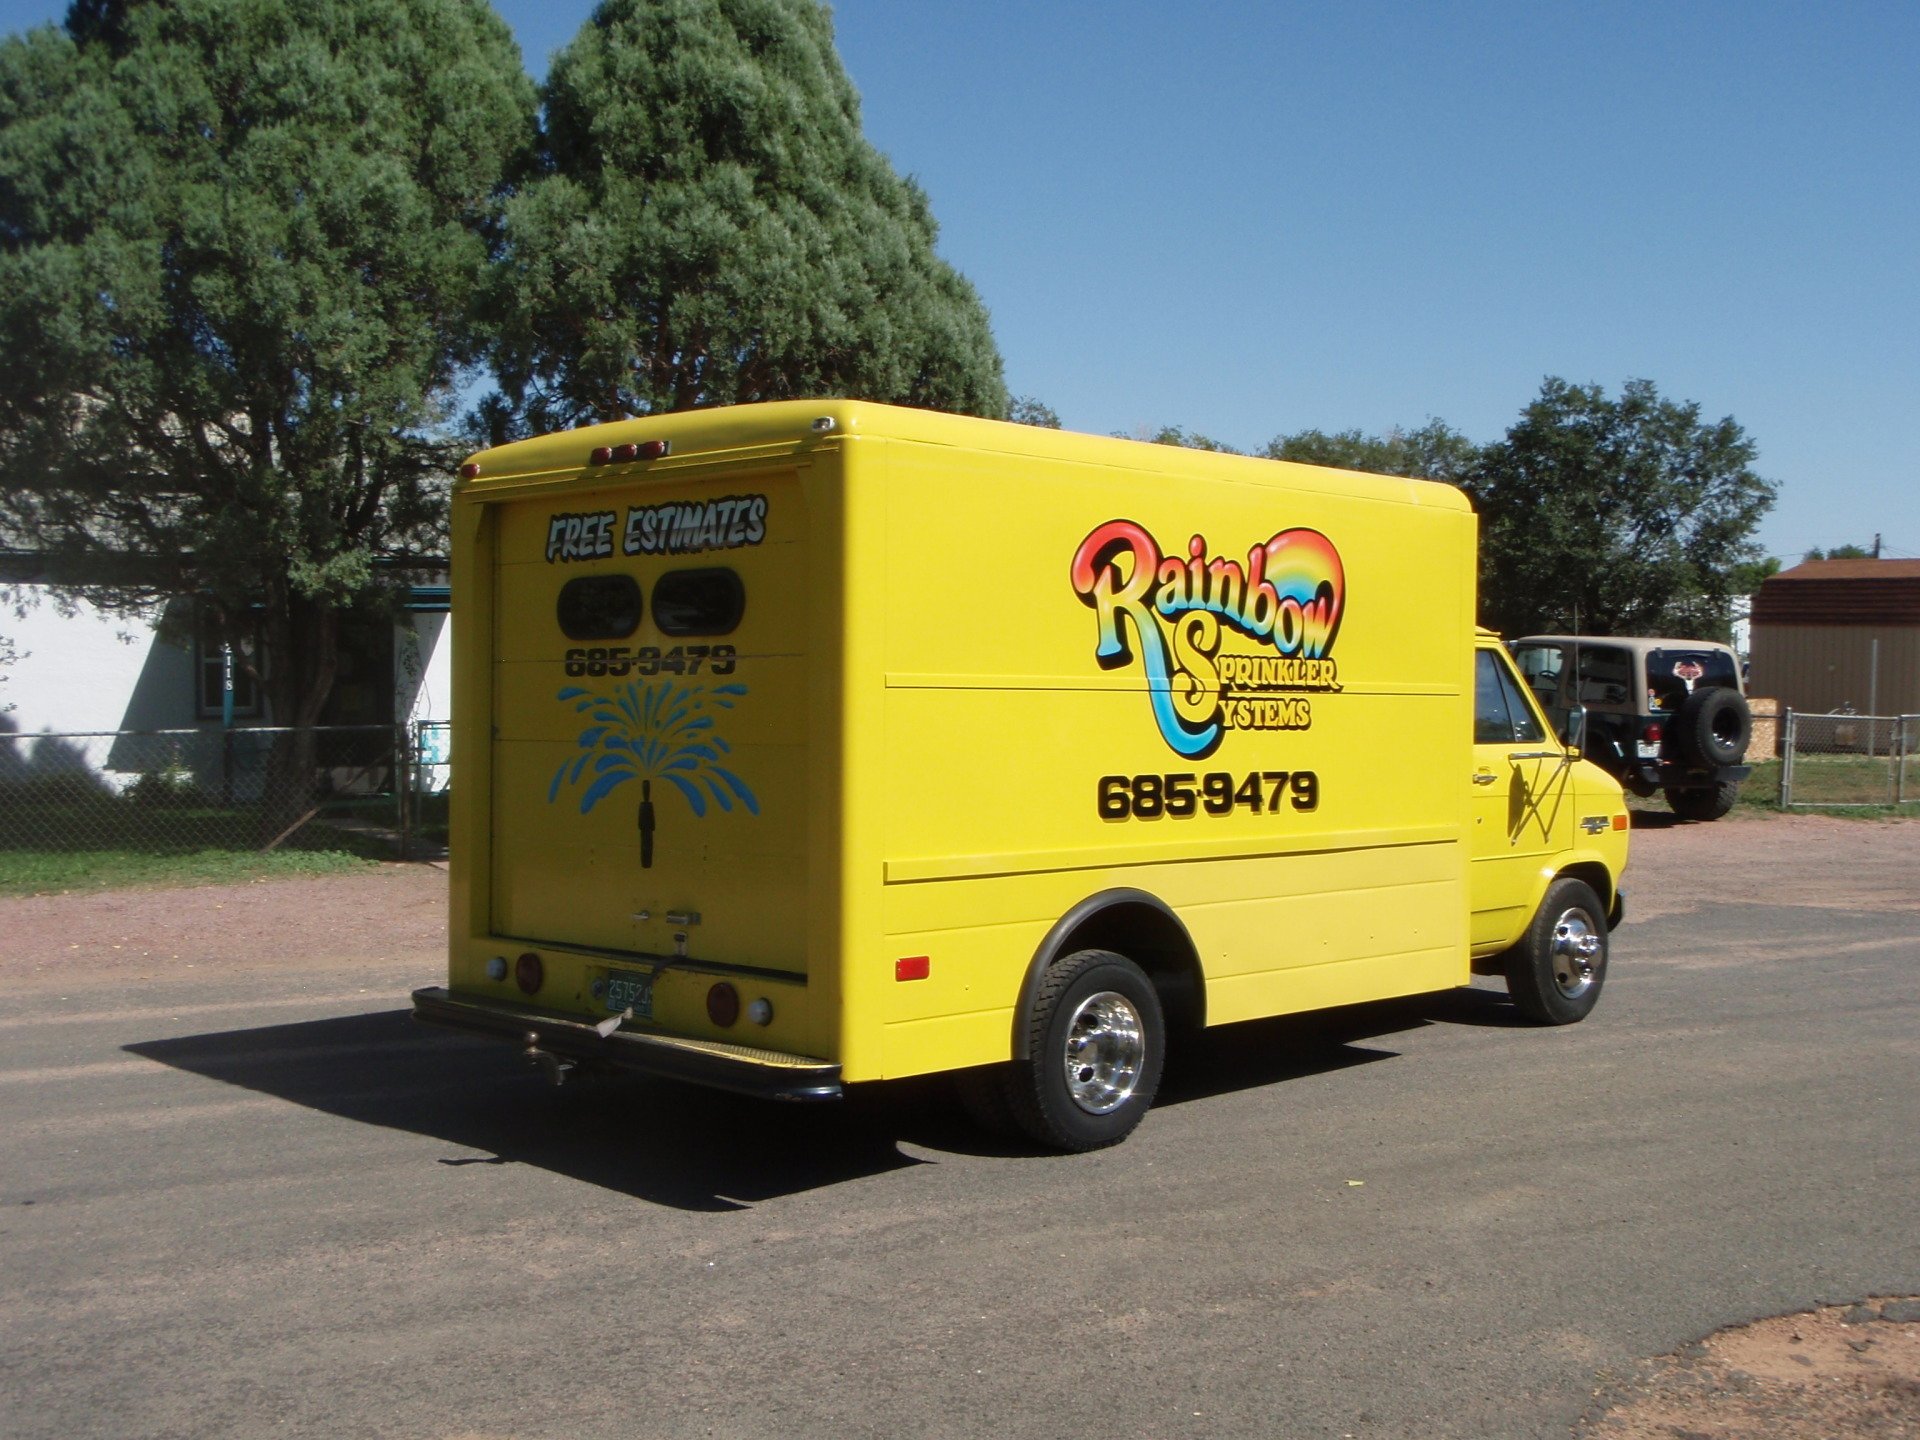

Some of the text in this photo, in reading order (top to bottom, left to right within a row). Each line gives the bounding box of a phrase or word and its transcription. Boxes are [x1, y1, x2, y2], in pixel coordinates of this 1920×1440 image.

[546, 494, 769, 564] FREE ESTIMATES
[1070, 518, 1346, 761] Rainbow
